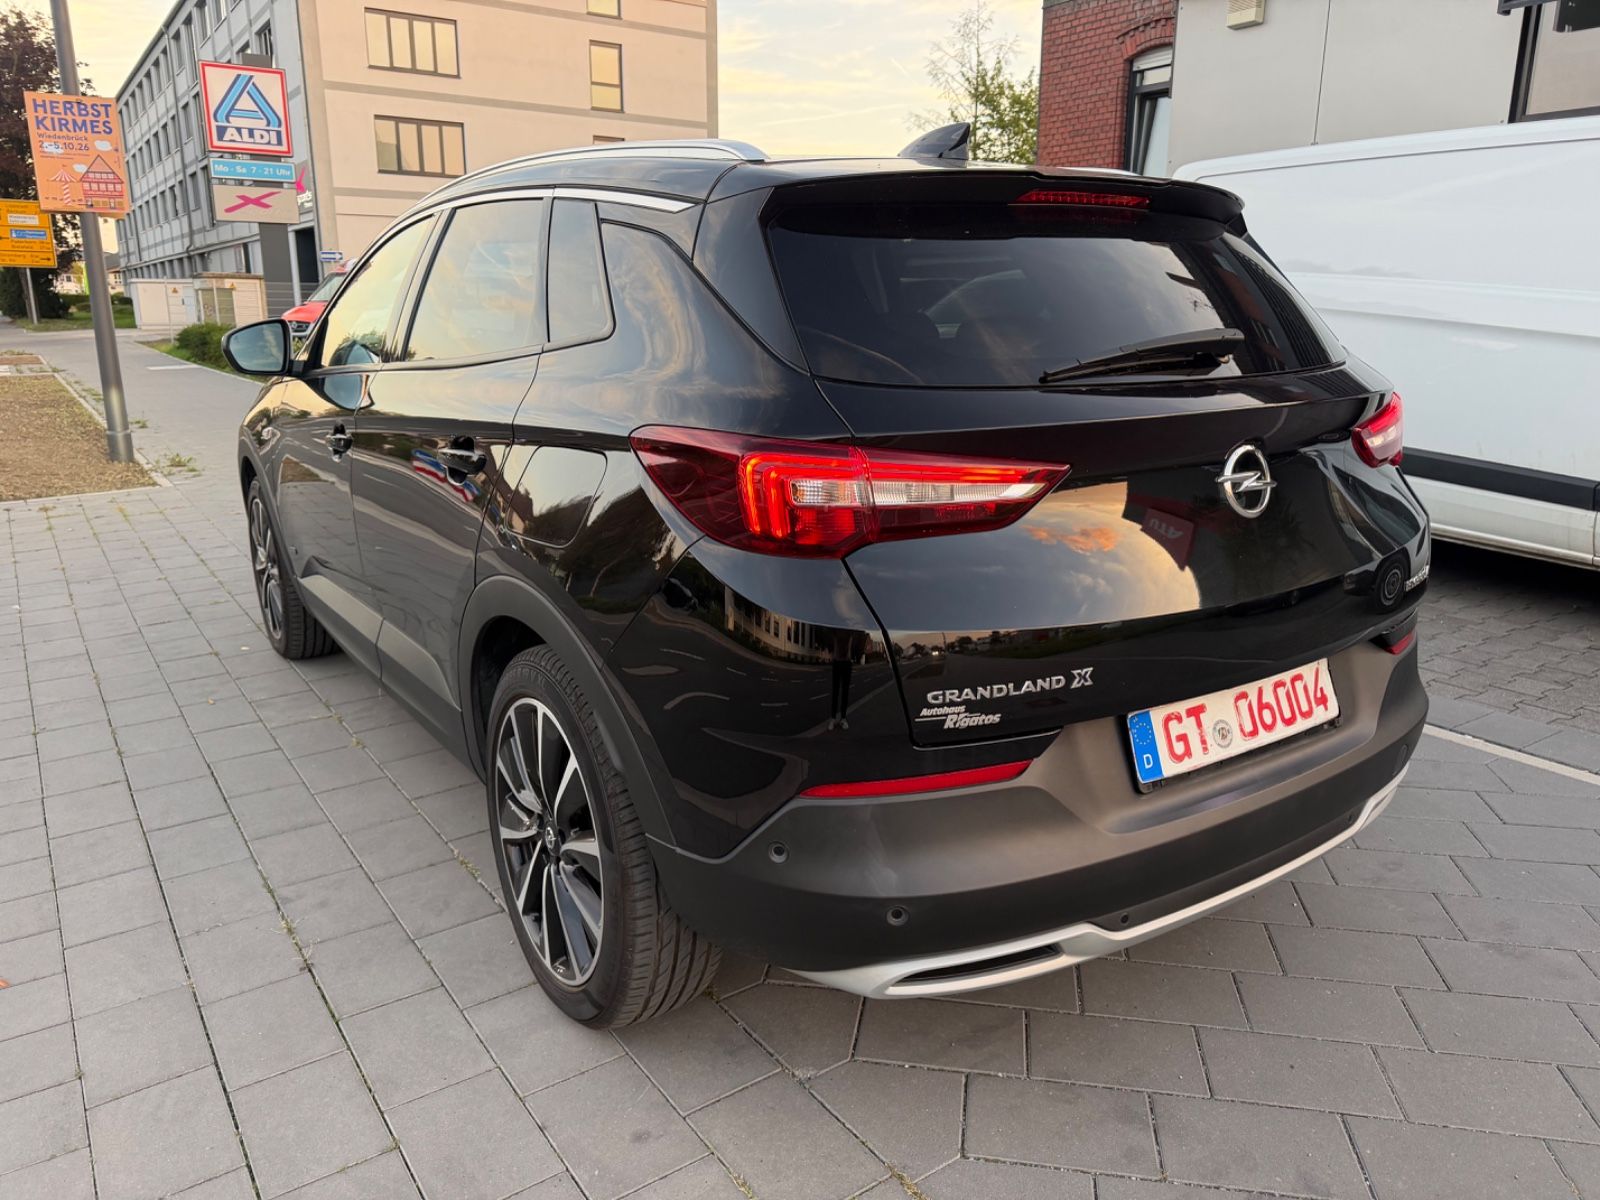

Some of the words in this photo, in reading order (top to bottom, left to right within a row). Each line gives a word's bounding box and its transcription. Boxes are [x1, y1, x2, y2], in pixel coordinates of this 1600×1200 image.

[32, 98, 112, 118] HERBST
[35, 115, 113, 135] KIRMES
[37, 132, 88, 141] Wiedenbrück
[222, 127, 278, 145] ALDI
[214, 164, 229, 173] Mo
[235, 164, 247, 173] Sa
[249, 166, 257, 174] 7
[263, 167, 274, 175] 21
[276, 169, 291, 177] Uhr
[926, 675, 1066, 704] GRANDLAND
[1070, 666, 1094, 689] X
[920, 705, 966, 717] Autohaus
[1161, 703, 1209, 765] GT
[1233, 666, 1329, 741] 06004
[1143, 753, 1154, 769] D
